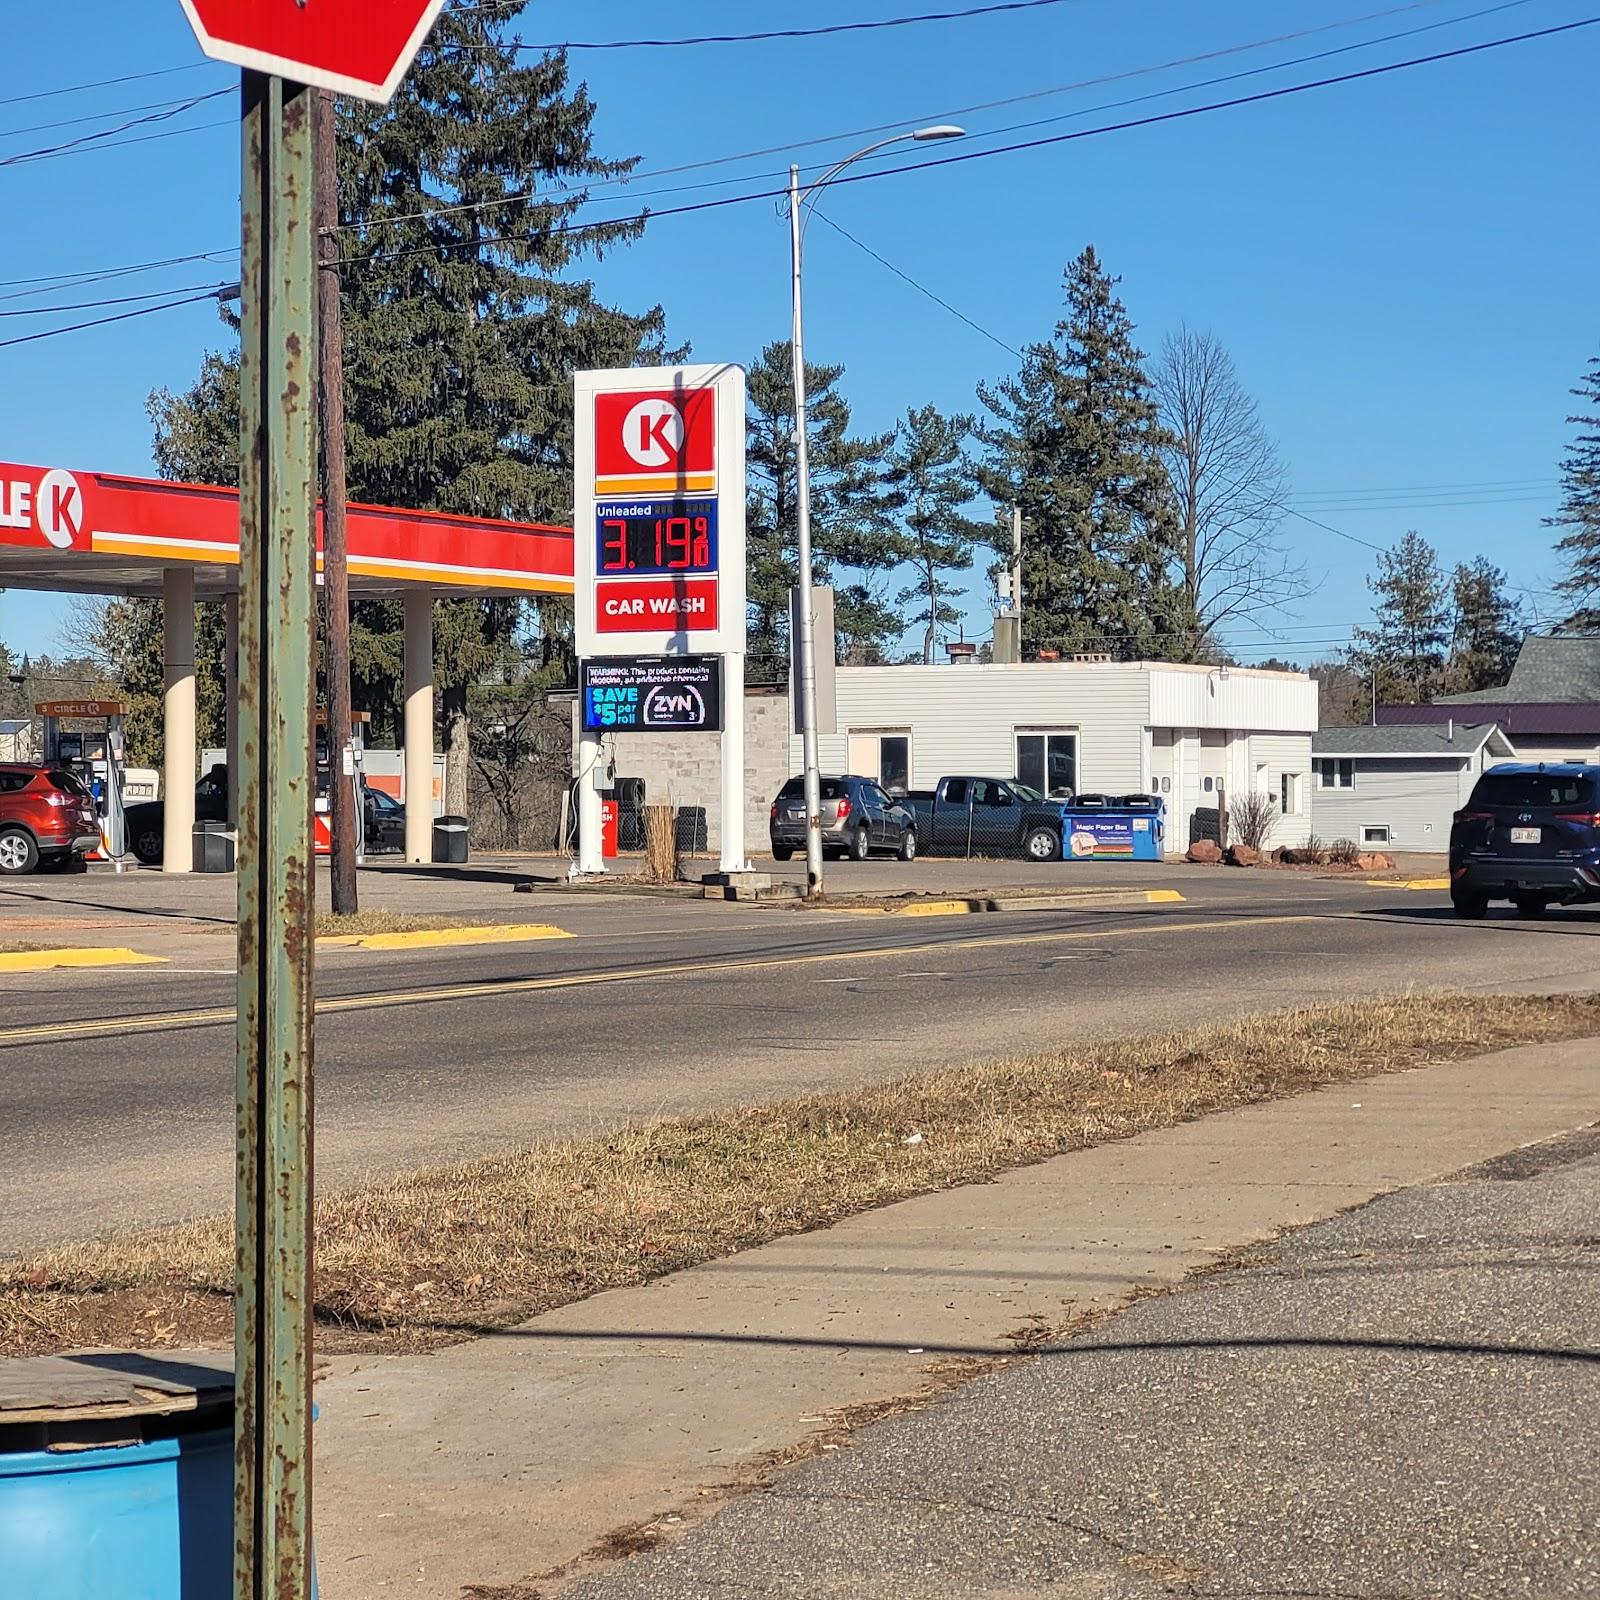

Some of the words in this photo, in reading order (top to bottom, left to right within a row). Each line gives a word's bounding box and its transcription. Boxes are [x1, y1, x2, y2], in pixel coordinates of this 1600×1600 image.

[597, 504, 652, 518] Unleaded
[605, 599, 644, 616] CAR
[649, 596, 706, 614] WASH
[630, 667, 646, 676] This
[647, 667, 677, 677] product
[592, 687, 639, 702] SAVE
[54, 704, 86, 713] CIRCLE
[653, 695, 692, 712] ZYN
[594, 703, 617, 726] $5
[617, 704, 637, 715] per
[617, 713, 636, 725] roll
[602, 813, 613, 821] SH
